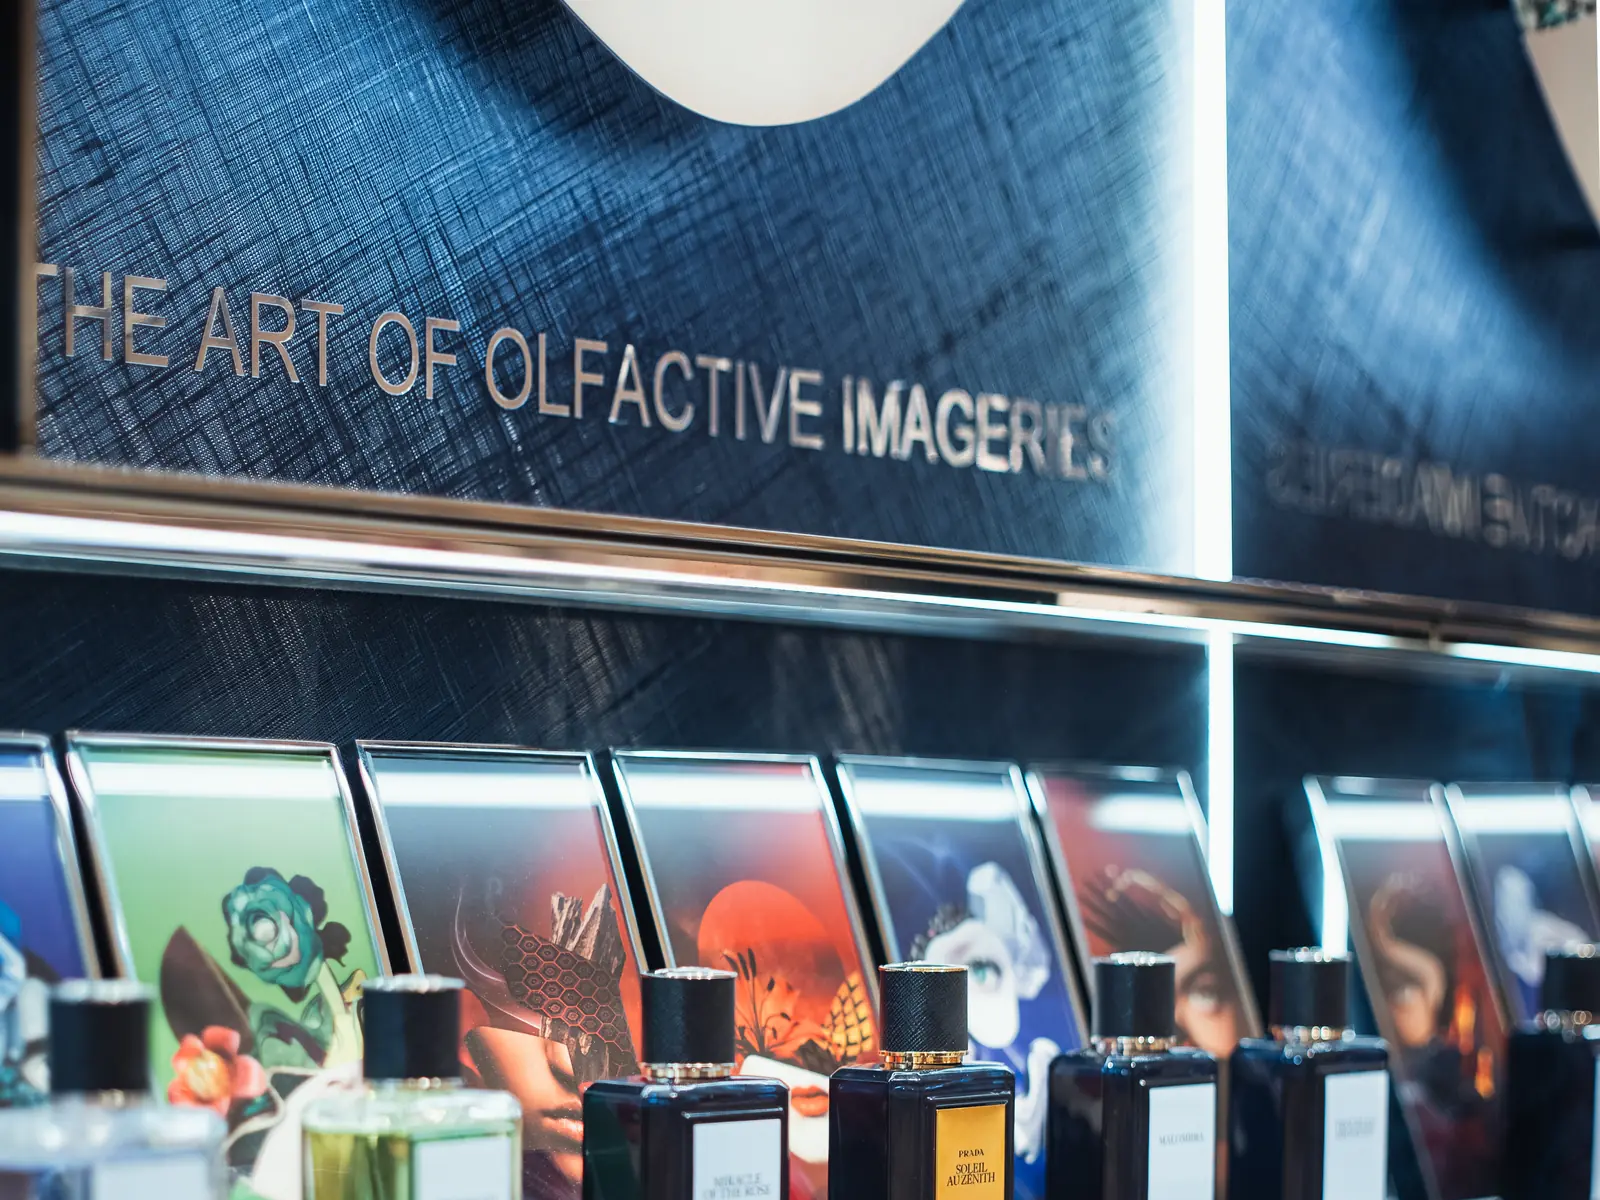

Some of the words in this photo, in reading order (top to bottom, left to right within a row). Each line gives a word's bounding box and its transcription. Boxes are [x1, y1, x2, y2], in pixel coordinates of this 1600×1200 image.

[194, 286, 344, 386] ART
[368, 311, 460, 400] OF
[484, 327, 824, 450] OLFACTIVE
[842, 374, 1119, 483] IMAGERIES
[958, 1148, 985, 1158] PRADA
[955, 1161, 988, 1175] SOLEIL
